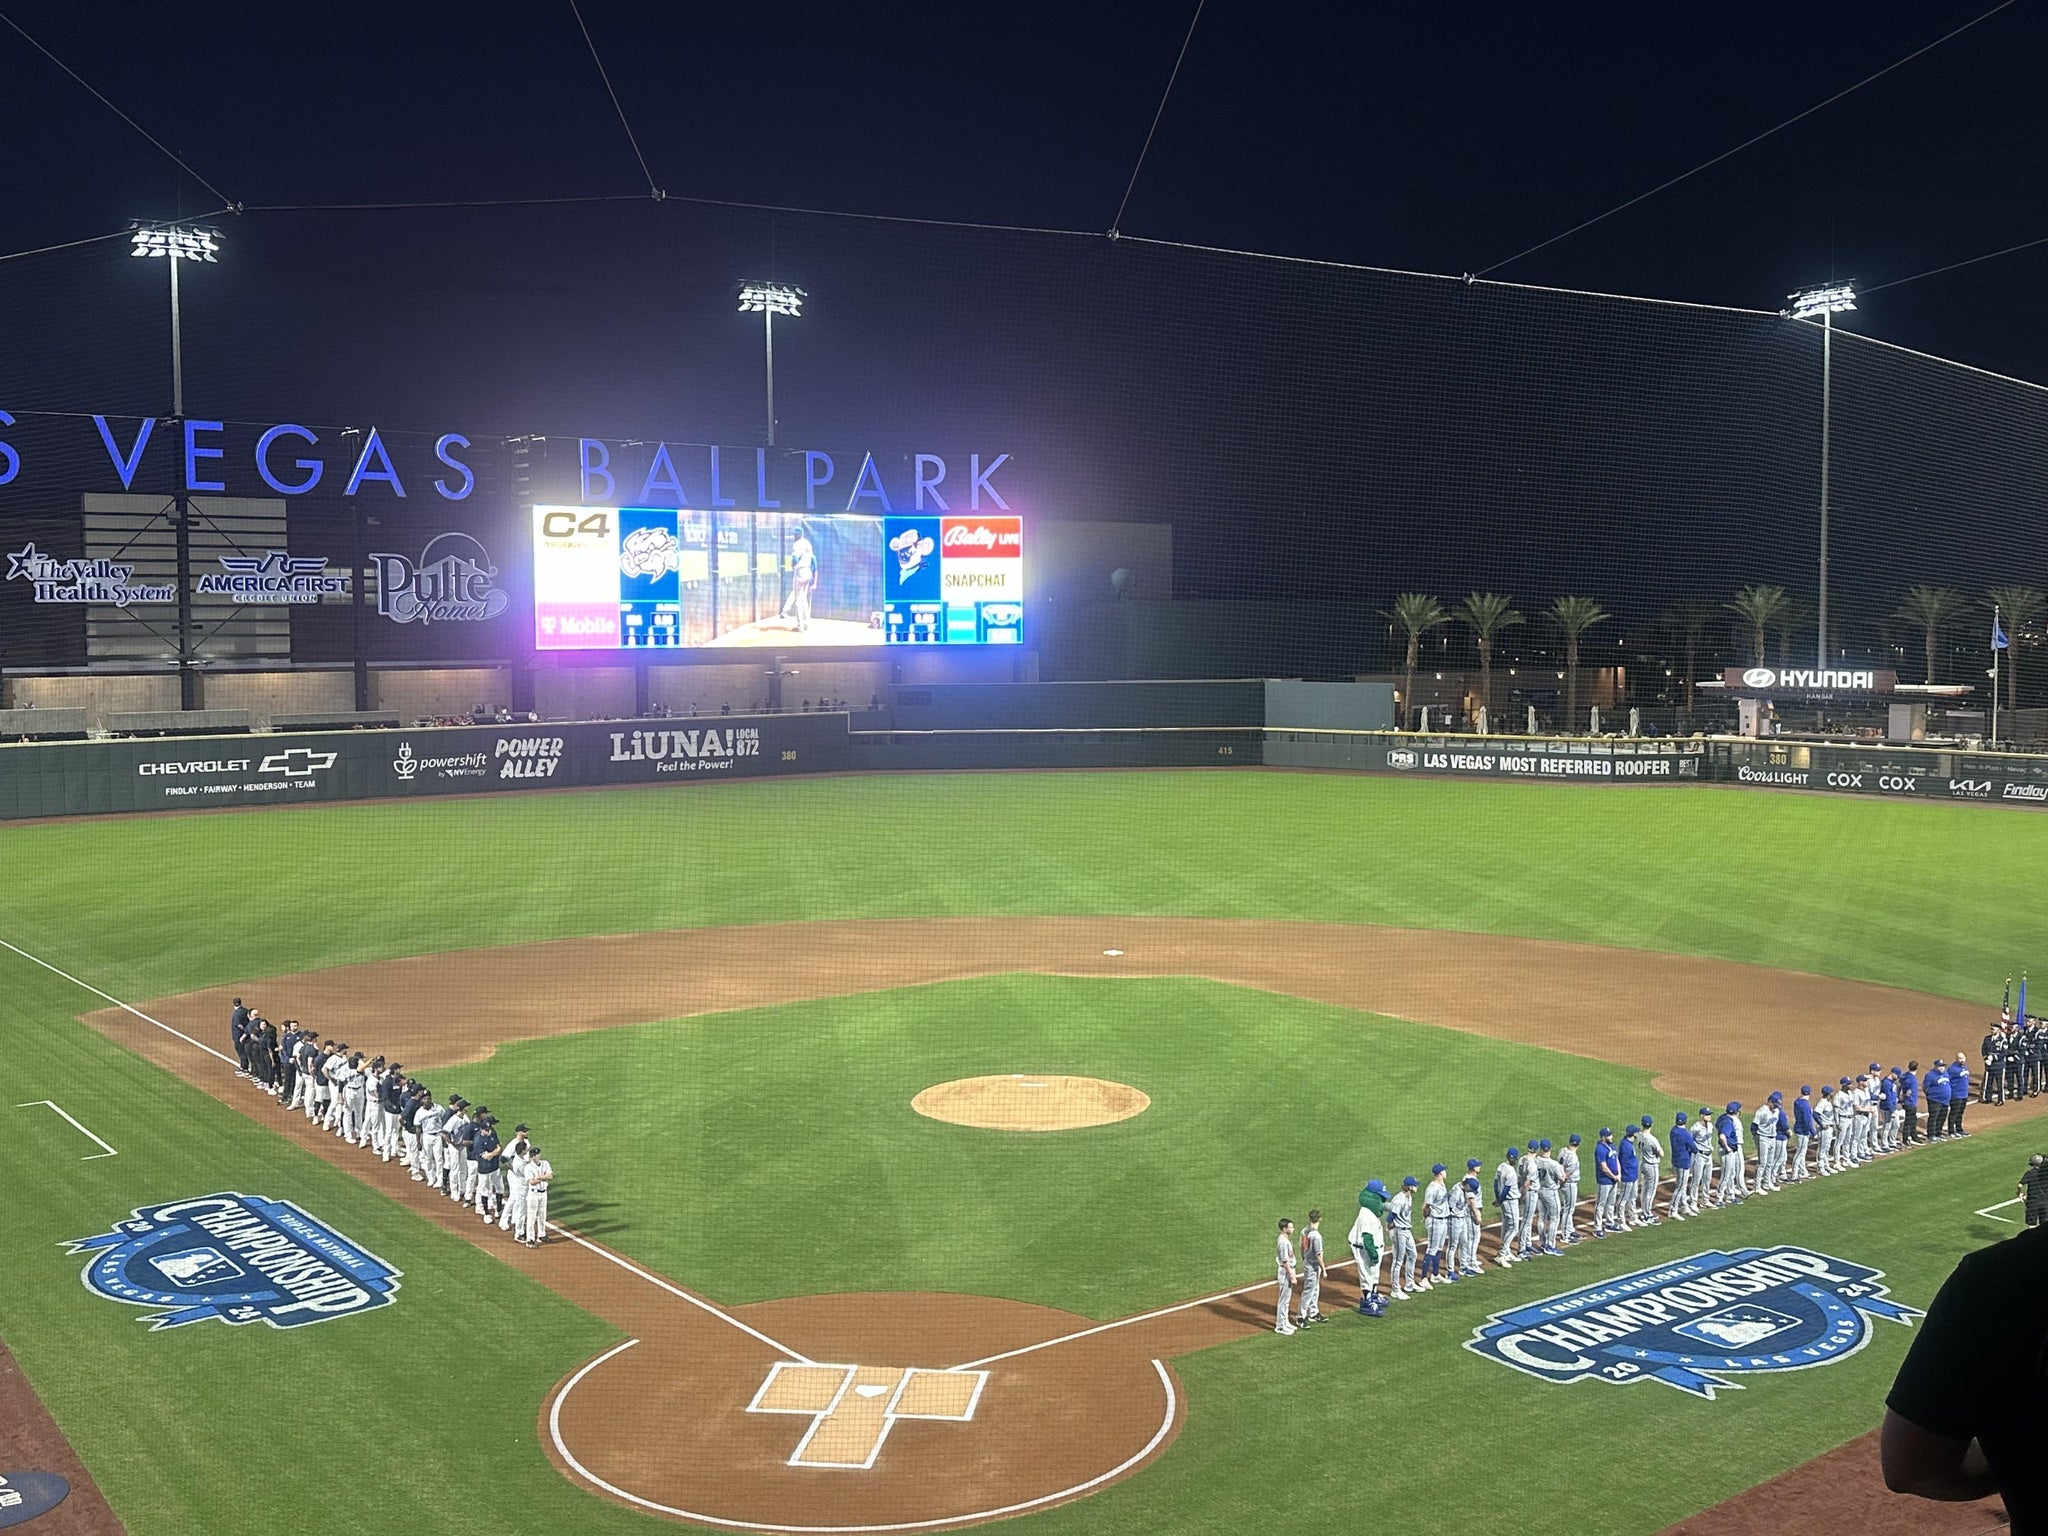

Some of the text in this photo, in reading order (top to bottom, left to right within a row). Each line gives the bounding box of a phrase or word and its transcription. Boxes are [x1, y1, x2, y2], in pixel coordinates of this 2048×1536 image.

[92, 414, 475, 500] VEGAS
[580, 437, 1012, 511] BALLPARK
[542, 512, 611, 538] C4
[36, 560, 133, 583] The Valley
[945, 573, 1006, 588] SNAPCHAT
[199, 577, 350, 592] AMERICA FIRST
[370, 554, 490, 613] Pulte
[36, 582, 173, 606] Health System
[396, 593, 500, 623] Homes
[1780, 670, 1873, 689] HYUNDAI
[736, 728, 760, 739] LOCAL
[494, 738, 564, 759] POWER
[609, 729, 734, 762] LiUNA!
[736, 740, 760, 756] 872
[1218, 746, 1233, 755] 415
[138, 759, 251, 776] CHEVROLET
[419, 752, 487, 771] powershift
[500, 757, 559, 779] ALLEY
[656, 758, 733, 772] Feel the Power!
[1423, 753, 1448, 769] LAS
[1500, 756, 1537, 773] MOST
[1540, 758, 1612, 776] REFERRED
[1615, 760, 1670, 776] ROOFER
[1769, 753, 1787, 765] 380
[1738, 765, 1809, 785] Coors LIGHT
[1826, 772, 1916, 791] COX COX
[165, 780, 316, 796] FINDLAY FAIRWAY HENDERSON TEAM
[1949, 779, 1992, 792] KIA
[2002, 783, 2048, 800] Findlay
[126, 1219, 154, 1233] 20
[276, 1212, 365, 1270] TRIPLE-A NATIONAL
[152, 1198, 372, 1316] CHAMPIONSHIP
[101, 1252, 175, 1304] LAS VEGAS
[1540, 1263, 1703, 1316] TRIPLE-A NATIONAL
[1836, 1281, 1874, 1299] 24
[228, 1306, 254, 1321] 24
[1496, 1252, 1852, 1371] CHAMPIONSHIP
[1723, 1318, 1856, 1368] LAS VEGAS
[1601, 1360, 1642, 1381] 20
